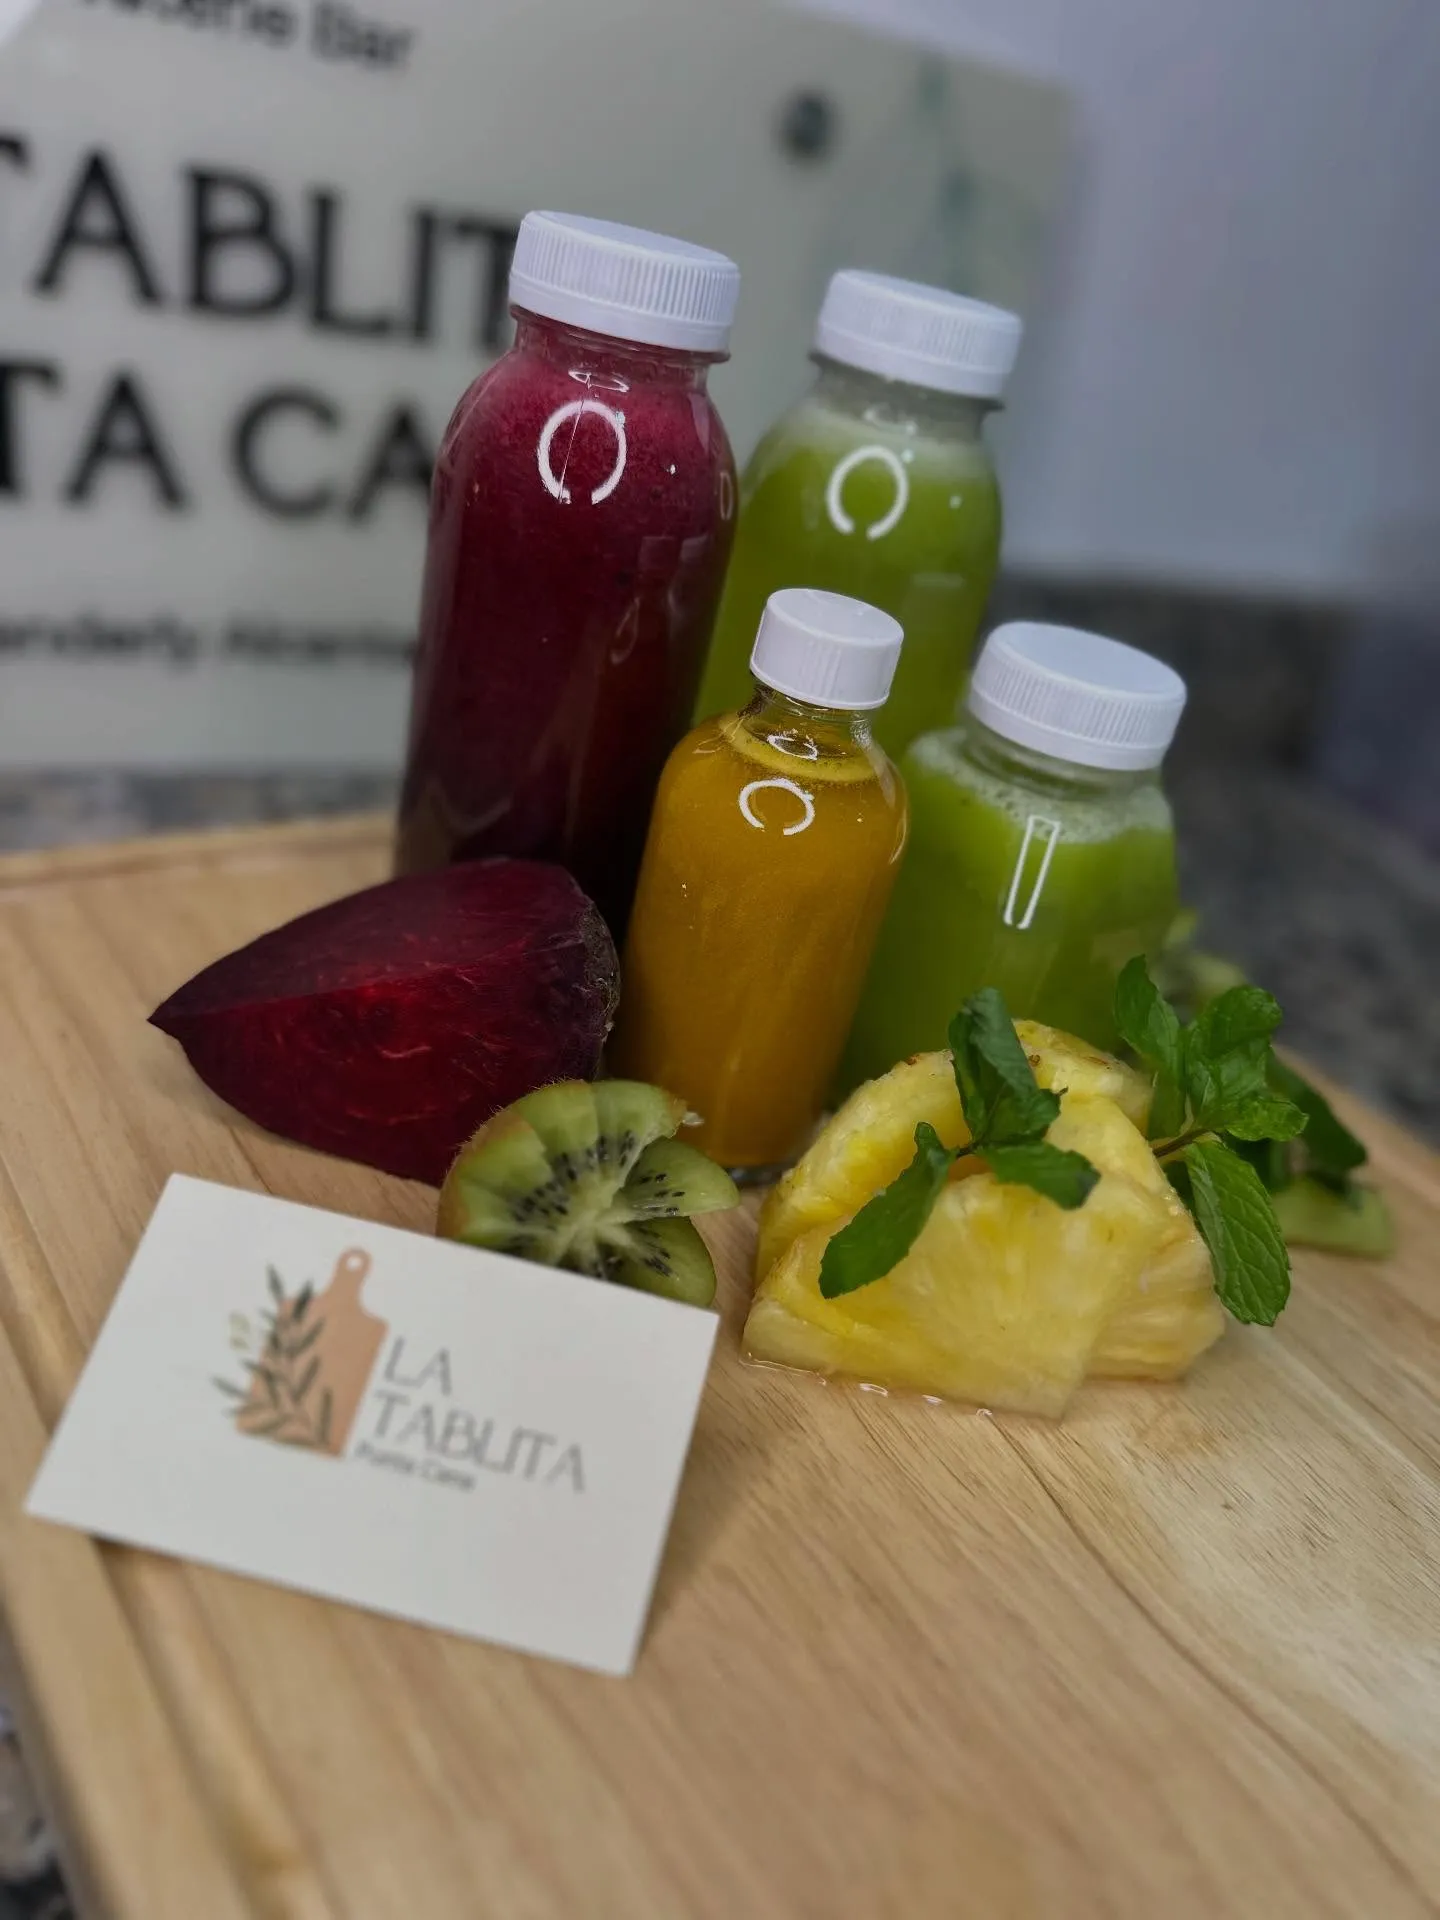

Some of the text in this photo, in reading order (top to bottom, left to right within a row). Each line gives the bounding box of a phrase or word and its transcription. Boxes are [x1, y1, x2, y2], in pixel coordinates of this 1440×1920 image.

[0, 133, 515, 357] ABLIT
[383, 1335, 452, 1397] LA
[372, 1388, 586, 1495] TABLITA
